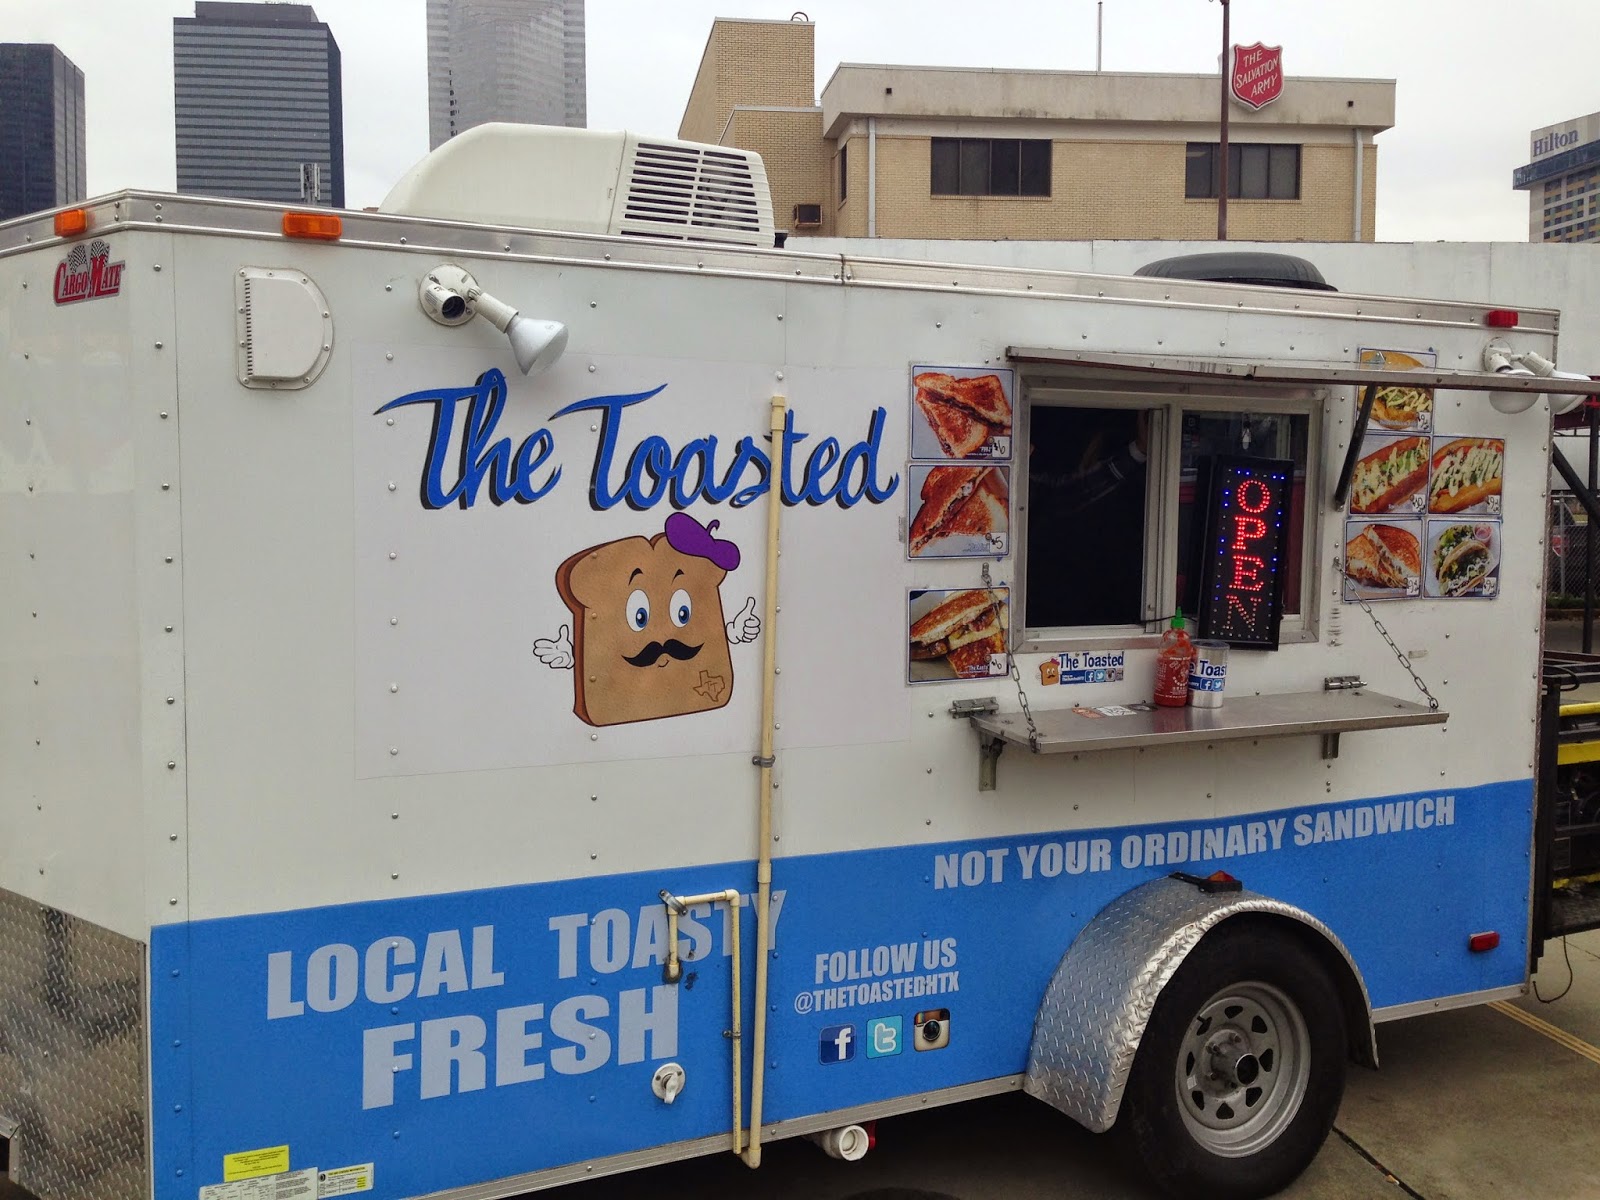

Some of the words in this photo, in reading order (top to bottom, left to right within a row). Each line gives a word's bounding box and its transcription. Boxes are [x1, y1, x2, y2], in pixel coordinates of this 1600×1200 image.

[1236, 56, 1279, 88] SALVATION
[1243, 49, 1263, 67] THE
[1251, 73, 1278, 98] ARMY
[1533, 129, 1579, 157] Hilton
[373, 367, 562, 510] The
[548, 383, 900, 511] Toasted
[1223, 479, 1270, 632] OPEN
[1059, 653, 1079, 670] The
[1083, 650, 1124, 668] Toasted
[934, 848, 1009, 891] NOT
[1017, 838, 1112, 881] YOUR
[1120, 818, 1288, 869] ORDINARY
[1293, 795, 1456, 846] SANDWICH
[267, 925, 505, 1020] LOCAL
[815, 942, 918, 985] FOLLOW
[923, 937, 957, 970] US
[794, 971, 960, 1015] @THETOASTEDHTX
[362, 983, 680, 1111] FRESH
